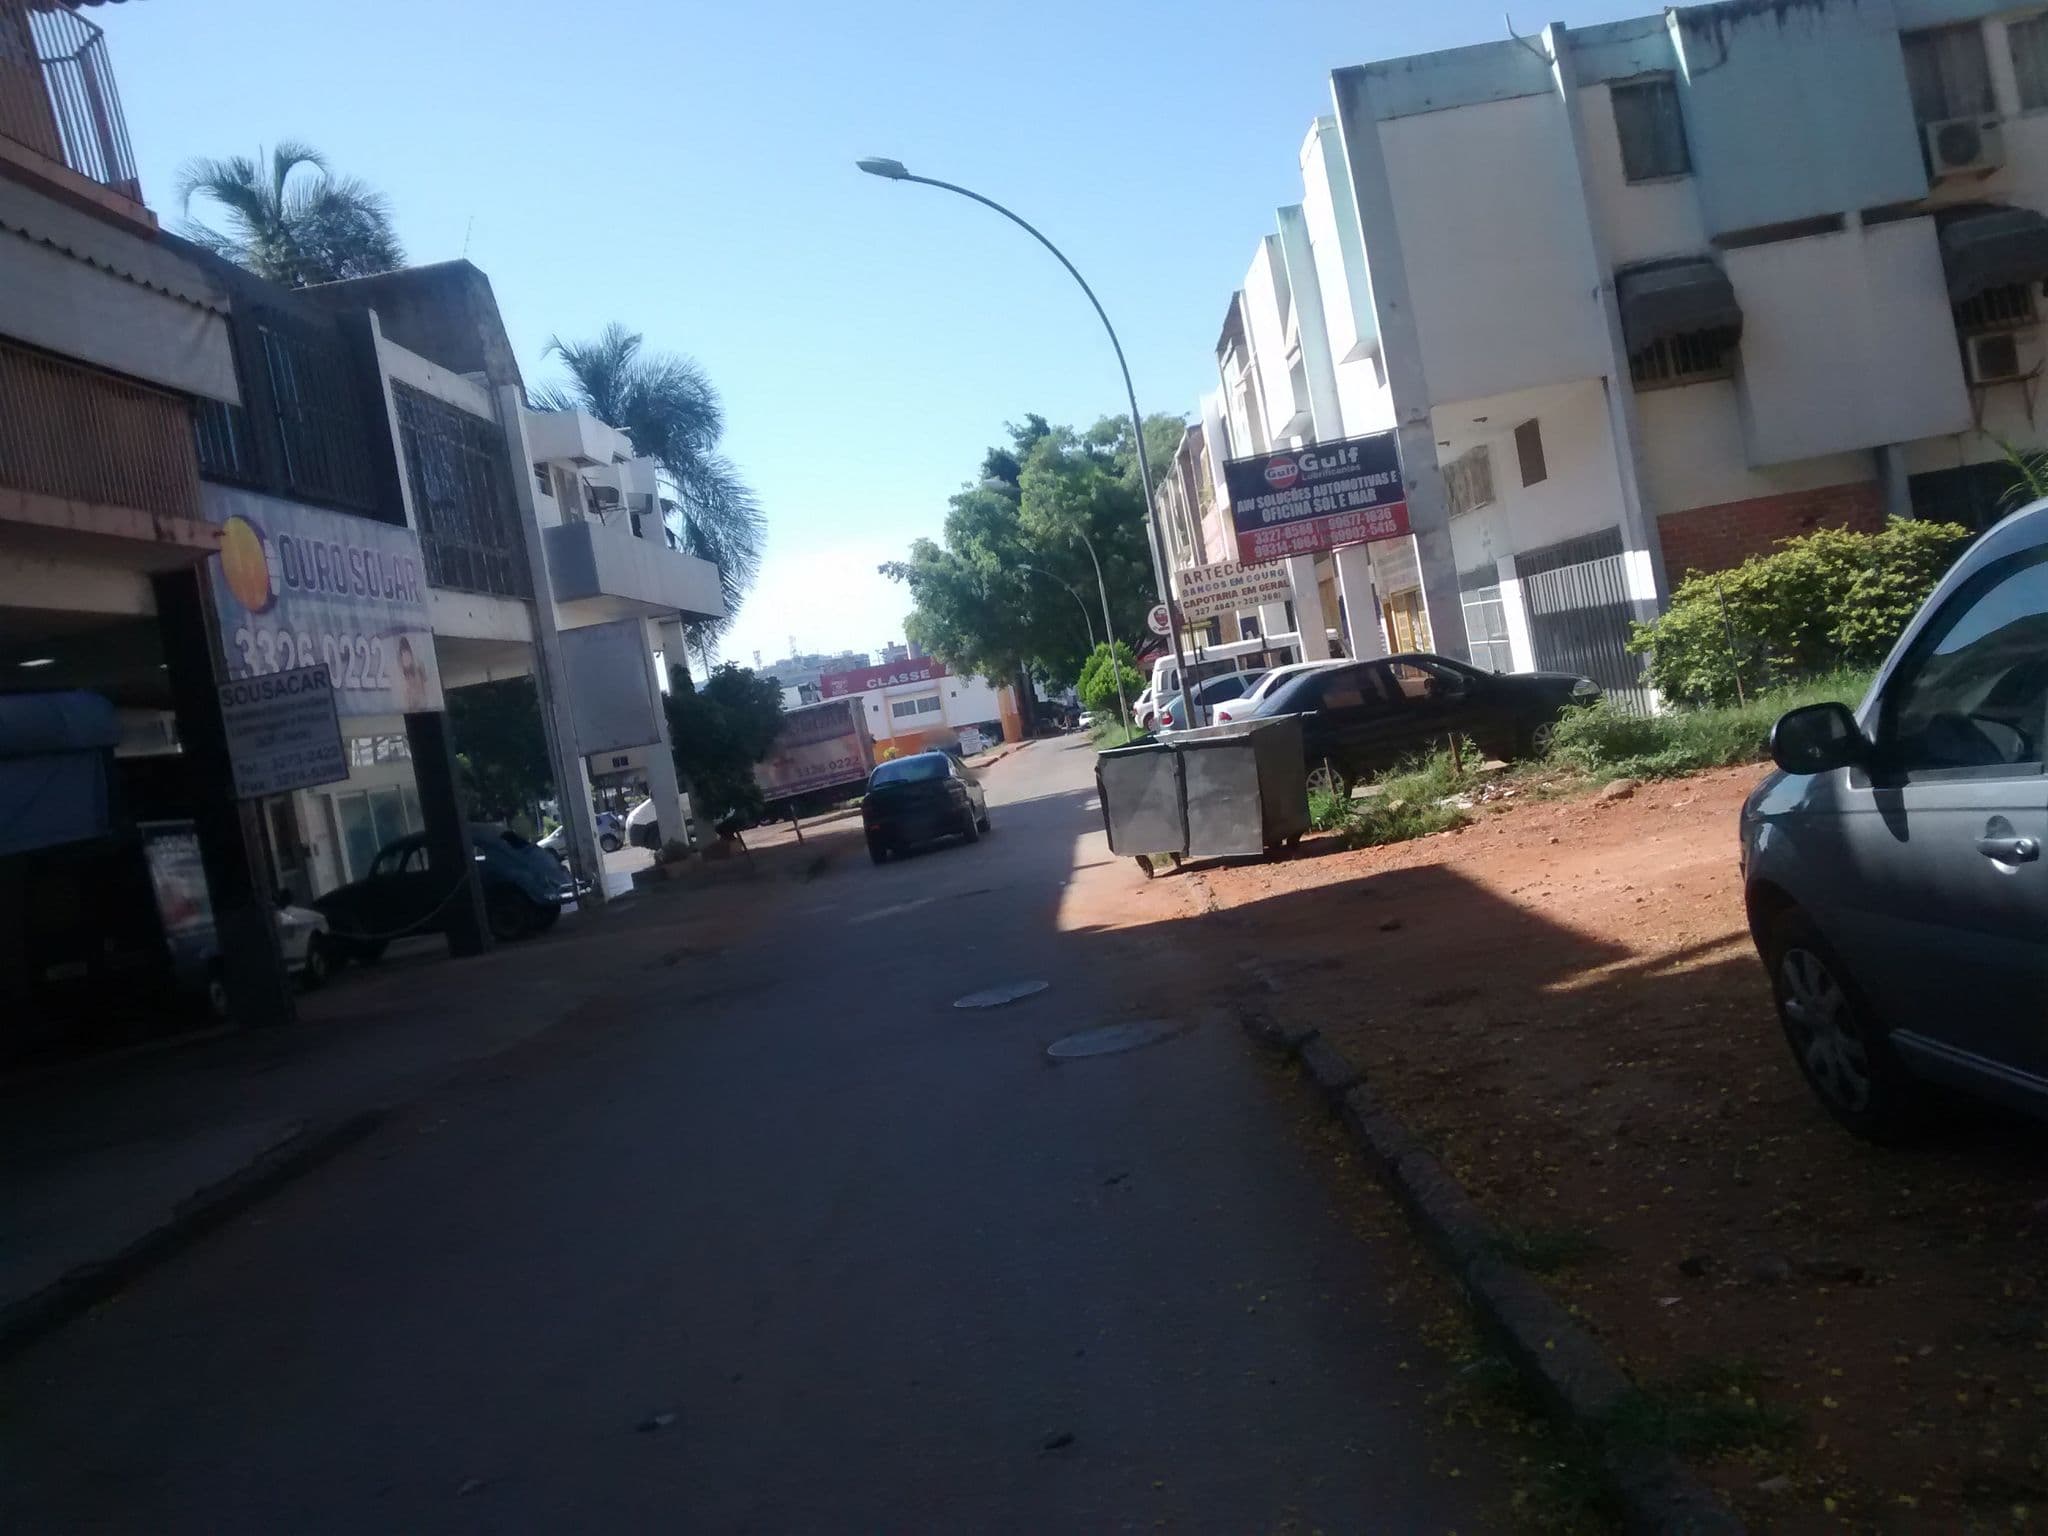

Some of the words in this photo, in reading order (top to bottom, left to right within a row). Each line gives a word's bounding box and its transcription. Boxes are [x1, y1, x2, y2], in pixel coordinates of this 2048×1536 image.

[1267, 466, 1296, 479] Gulf
[1299, 447, 1358, 472] Gulf
[1256, 487, 1312, 509] SOLUÇÕES
[1313, 472, 1390, 498] AUTOMOTIVAS
[1391, 470, 1398, 483] E
[1262, 500, 1312, 523] OFICINA
[1313, 496, 1337, 512] SOL
[1338, 493, 1347, 508] E
[1348, 488, 1377, 506] MAR
[278, 534, 349, 594] OURO
[348, 547, 422, 603] SOLAR
[1182, 581, 1227, 598] BANCOS
[1229, 577, 1244, 587] EM
[1246, 568, 1285, 584] COURO
[1183, 590, 1239, 610] CAPOTARIA
[1241, 585, 1257, 596] EM
[1258, 579, 1291, 592] GERAL
[235, 626, 315, 678] 3326
[323, 633, 390, 690] 0222
[221, 670, 328, 707] SOUSACAR
[866, 669, 931, 689] CLASSE
